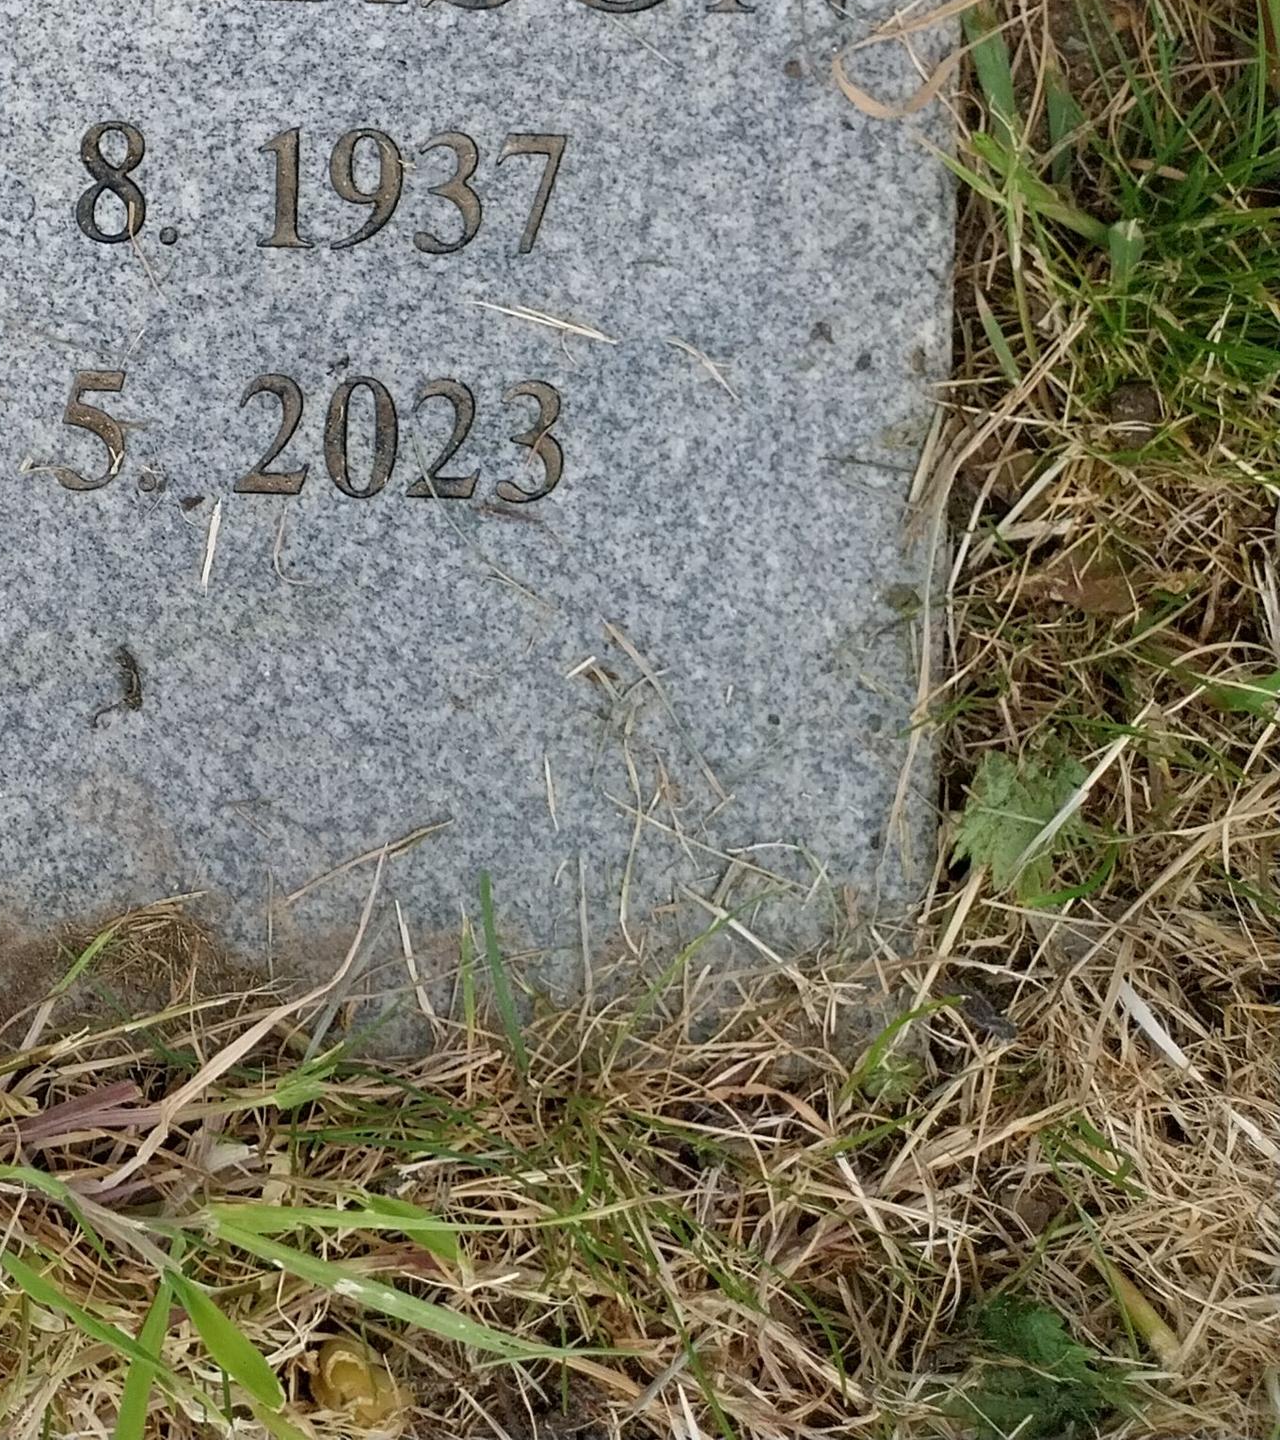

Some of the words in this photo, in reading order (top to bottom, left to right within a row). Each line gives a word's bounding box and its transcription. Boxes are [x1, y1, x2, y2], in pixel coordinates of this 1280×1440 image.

[73, 119, 180, 246] 8.
[257, 126, 568, 256] 1937
[52, 370, 163, 493] 5.
[232, 373, 566, 506] 2023
